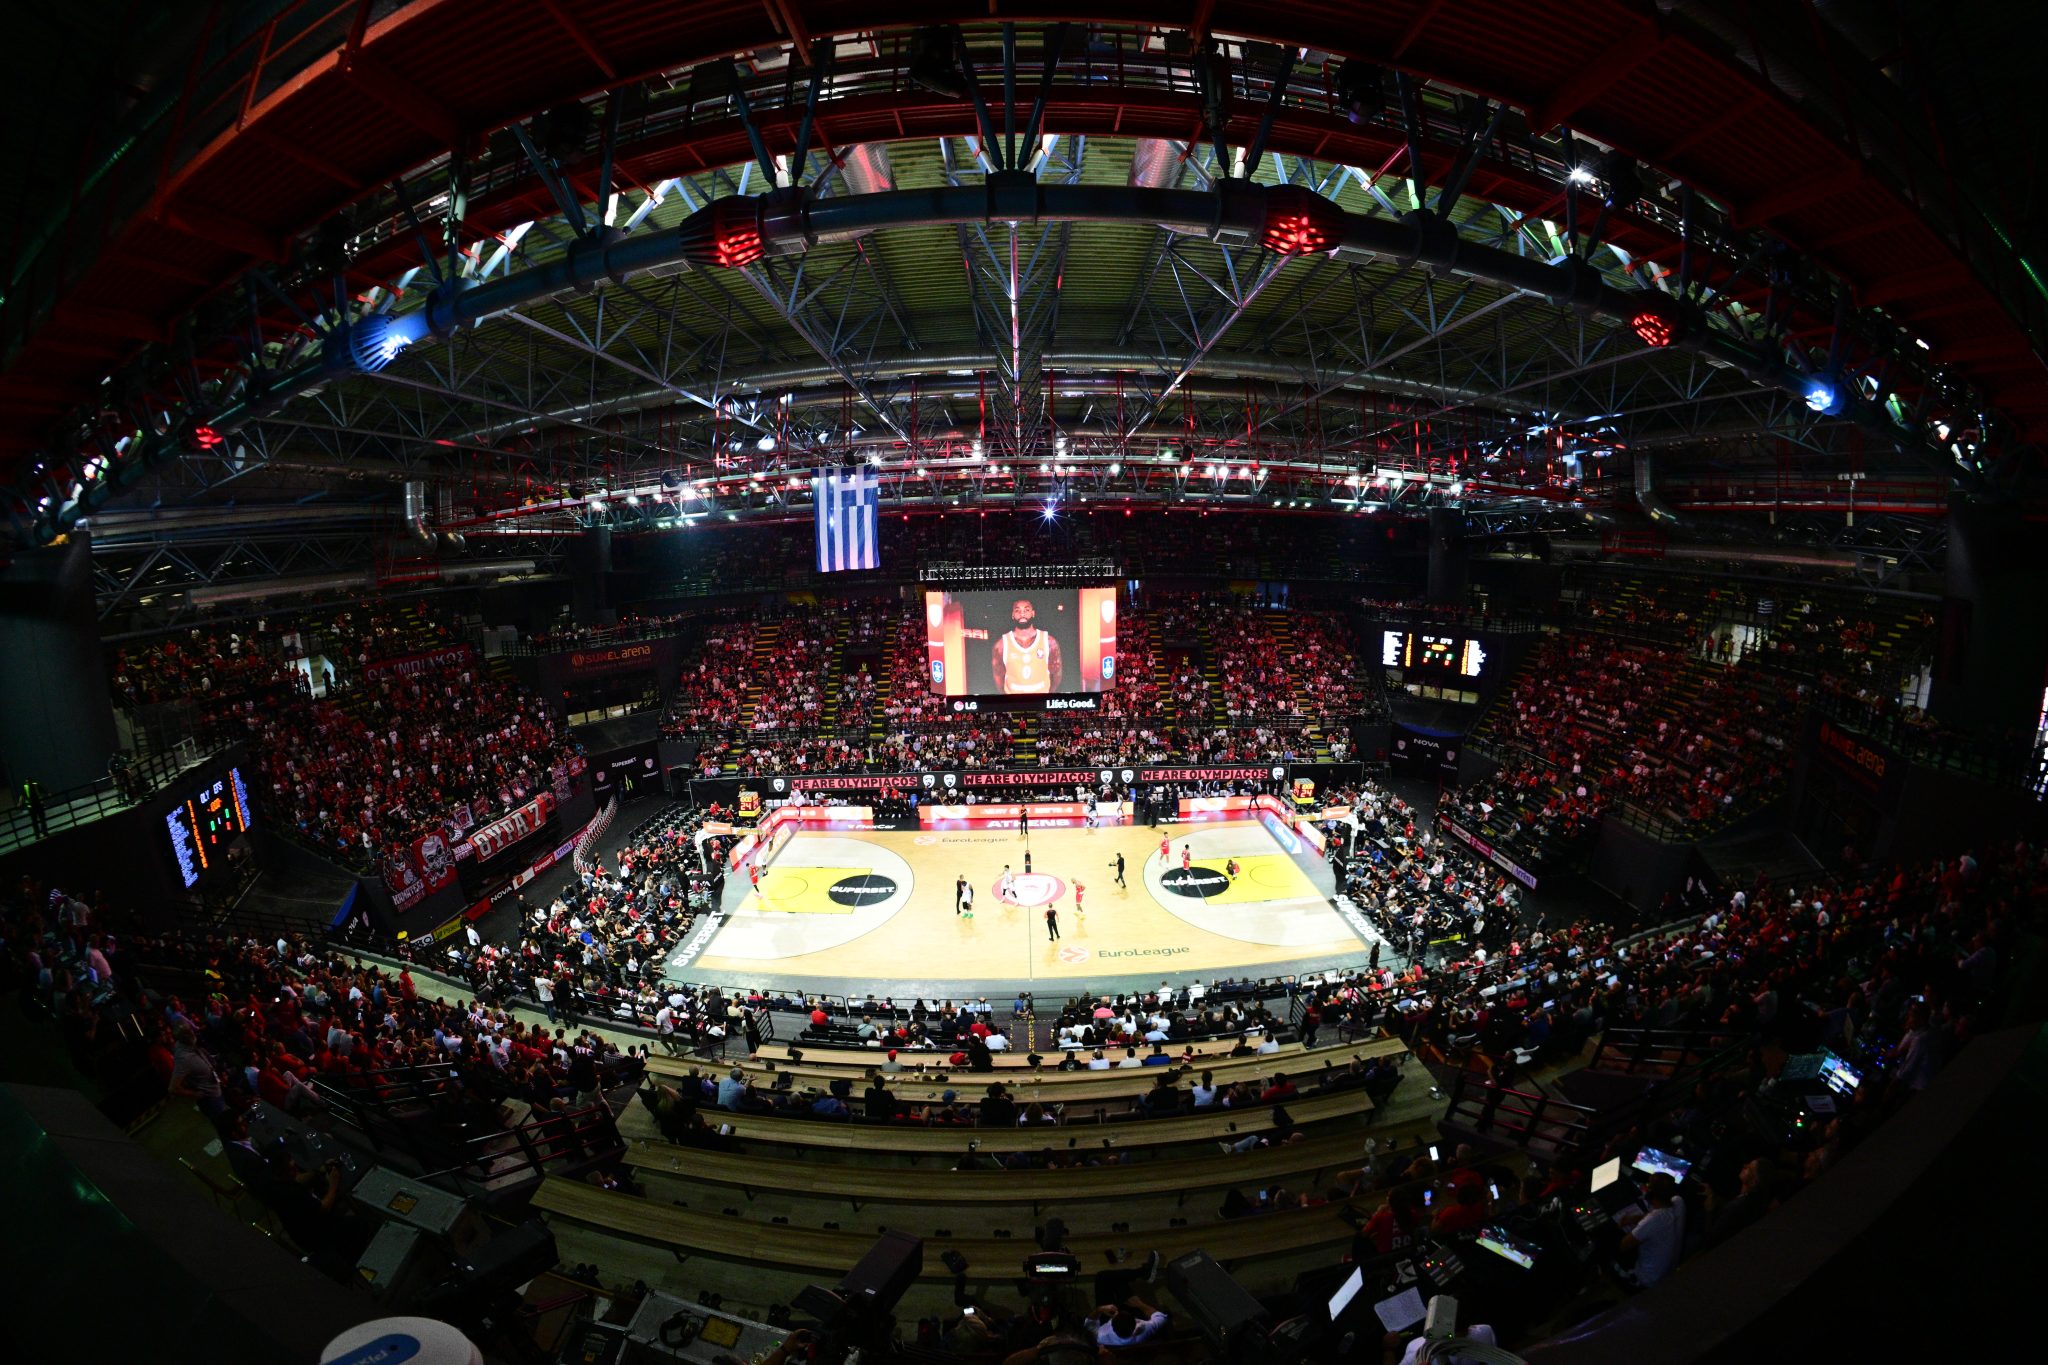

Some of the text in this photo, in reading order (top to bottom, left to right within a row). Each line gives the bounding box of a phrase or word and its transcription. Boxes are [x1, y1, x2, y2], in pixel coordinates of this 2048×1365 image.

[621, 645, 651, 659] arena
[965, 702, 977, 710] LG
[1046, 699, 1096, 709] Life's Good.
[1413, 738, 1440, 749] NOVA
[611, 756, 637, 768] SUPERBET
[1391, 752, 1409, 760] NOVA
[1856, 745, 1886, 777] arena
[1440, 763, 1458, 771] NOVA
[964, 772, 1096, 785] WE ARE OLYMPIACOS
[1142, 768, 1268, 780] WE ARE OLYMPIACOS
[792, 776, 918, 789] WE ARE OLYMPIACOS
[199, 789, 210, 804] OLY
[1300, 789, 1313, 798] 24
[740, 802, 752, 811] 24
[527, 803, 541, 827] 7
[986, 819, 1070, 828] ATHENS
[490, 886, 513, 903] NOVA
[671, 910, 726, 968] SUPERBET
[1098, 947, 1190, 957] EuroLeague
